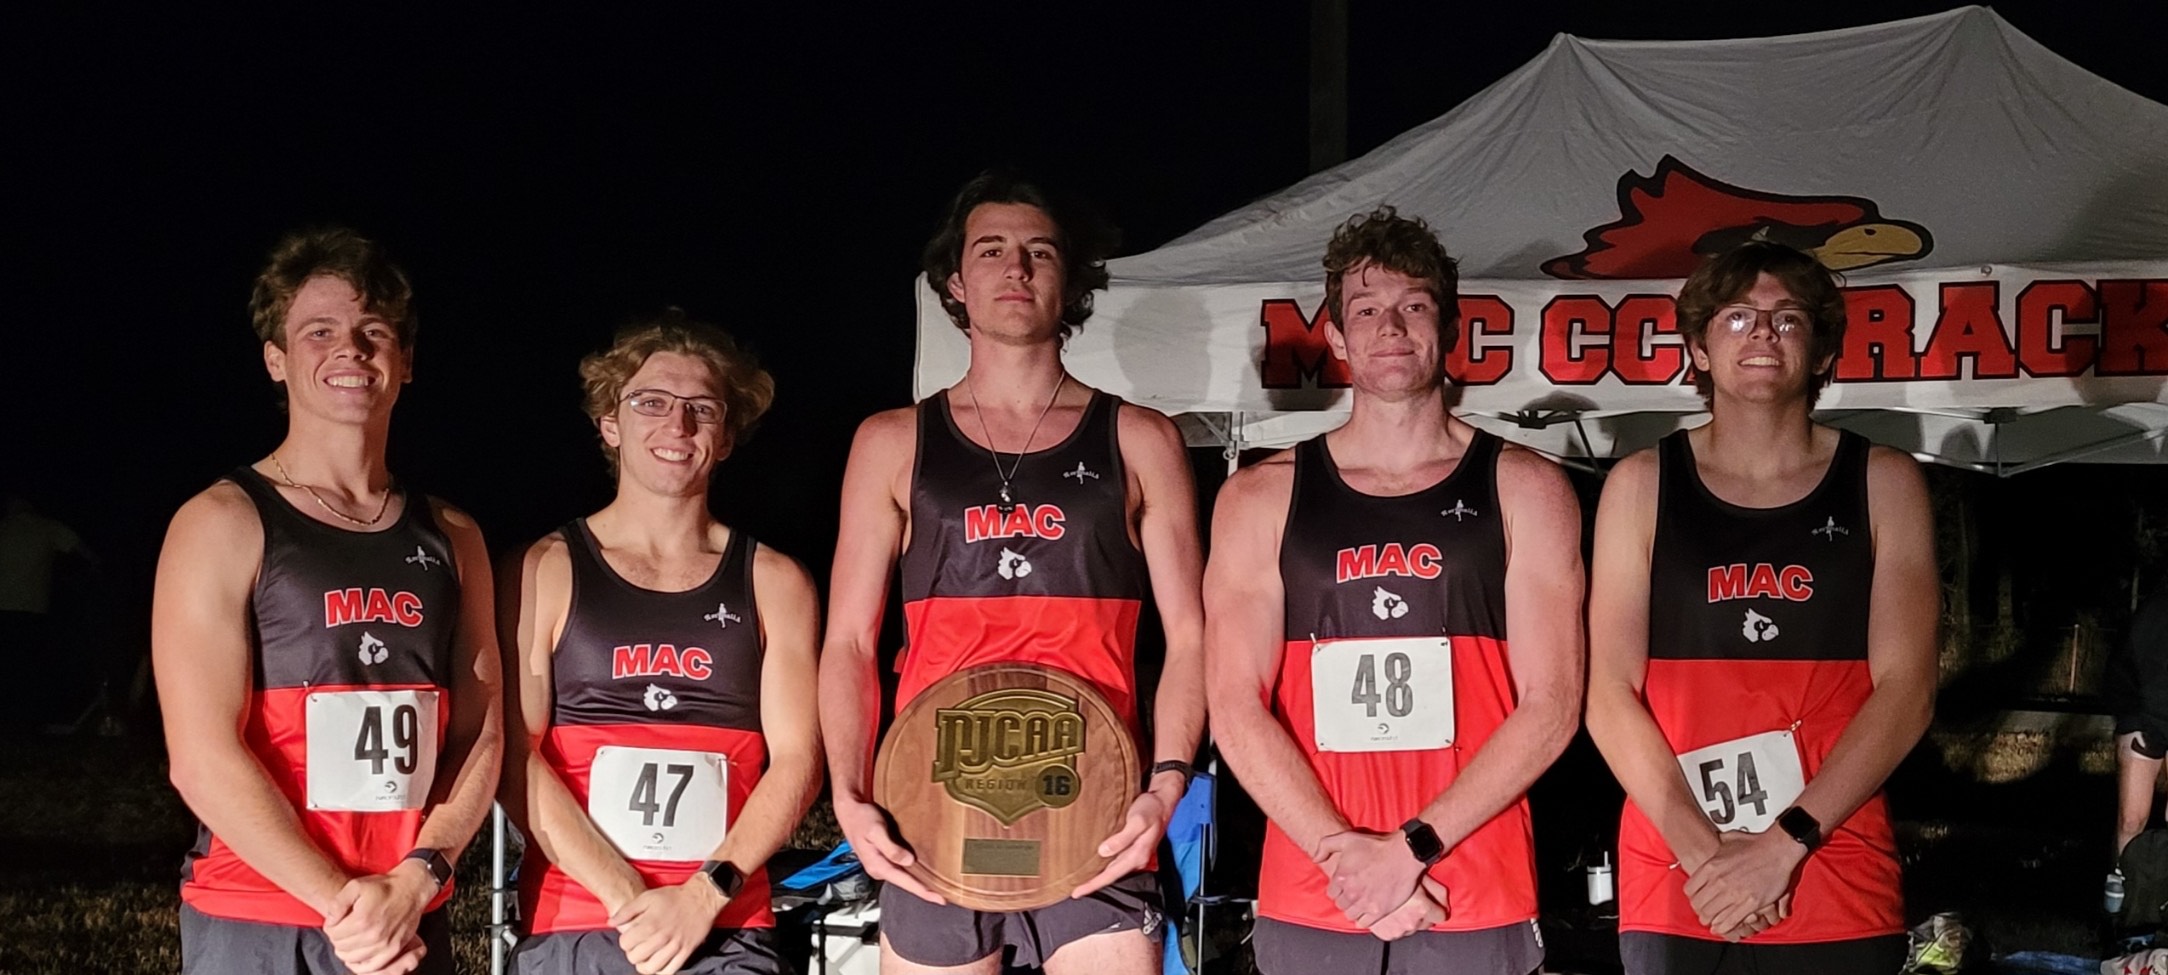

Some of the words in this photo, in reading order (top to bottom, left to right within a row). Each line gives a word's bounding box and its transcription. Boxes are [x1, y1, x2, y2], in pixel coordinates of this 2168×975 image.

[1261, 294, 1515, 388] MC
[965, 504, 1067, 543] MAC
[1336, 543, 1443, 584] MAC
[1708, 563, 1814, 603] MAC
[324, 588, 424, 628] MAC
[612, 644, 713, 681] MAC
[1351, 652, 1412, 718] 48
[354, 704, 418, 775] 49
[937, 711, 1081, 777] NJCAA
[628, 763, 694, 827] 47
[964, 778, 1027, 792] REGION
[1043, 775, 1071, 796] 16
[1699, 751, 1768, 825] 54
